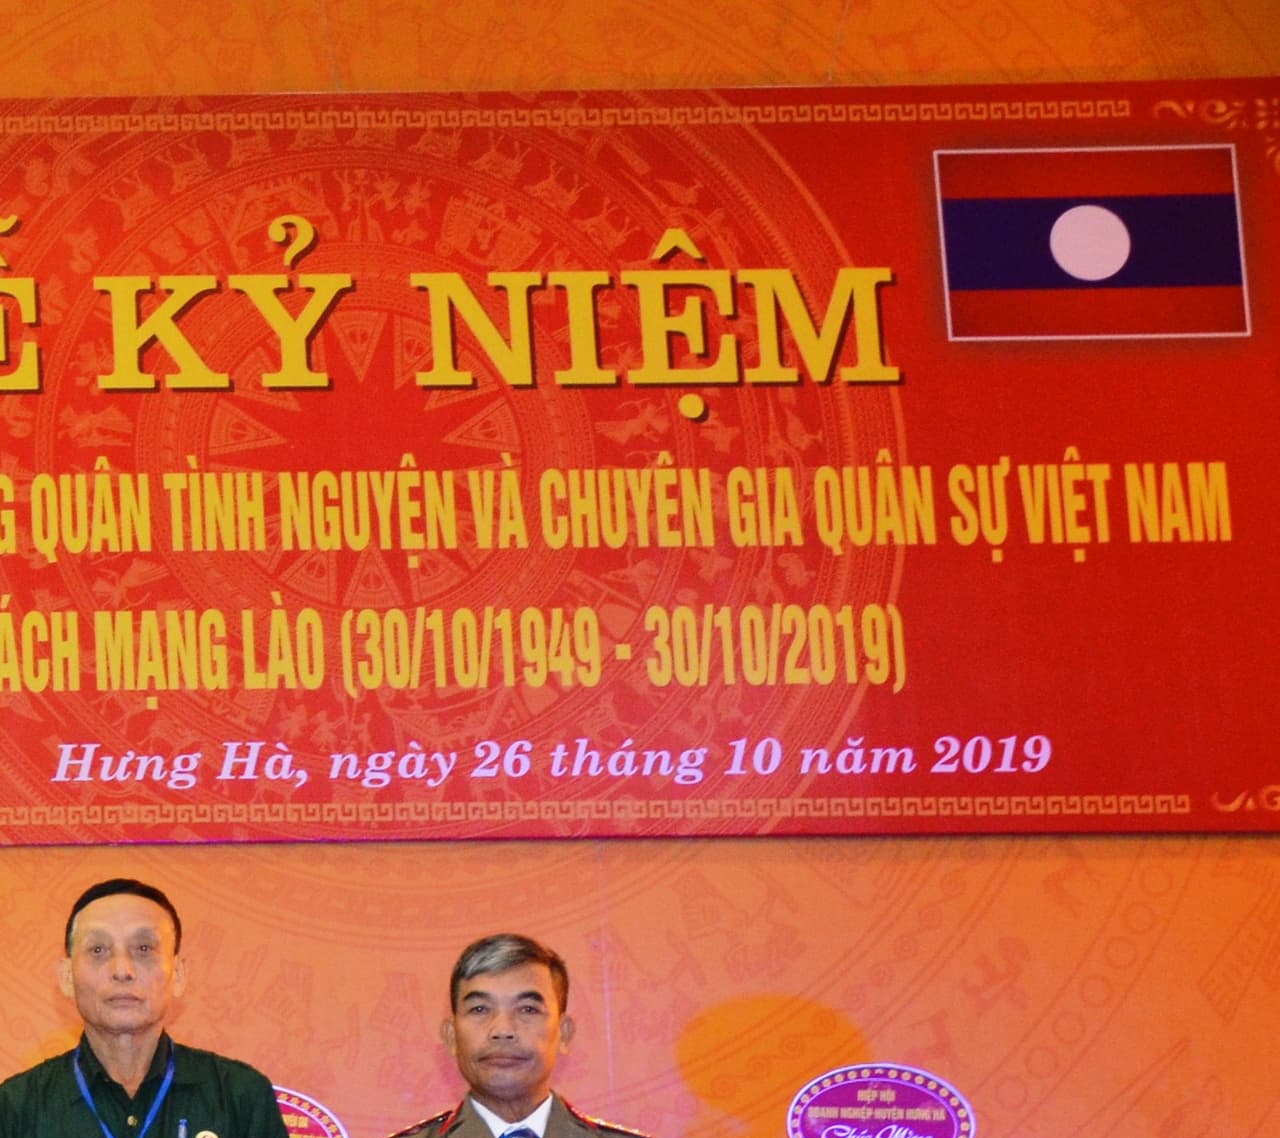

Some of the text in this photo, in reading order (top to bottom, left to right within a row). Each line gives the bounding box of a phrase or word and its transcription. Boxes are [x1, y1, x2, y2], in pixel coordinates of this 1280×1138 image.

[93, 215, 352, 389] KỶ
[410, 229, 899, 418] NIỆM
[30, 456, 152, 563] QUÂN
[163, 455, 266, 552] TÌNH
[278, 453, 457, 569] NGUYỆN
[468, 452, 529, 549] VÀ
[540, 451, 715, 549] CHUYÊN
[727, 467, 803, 547] GIA
[814, 450, 935, 555] QUÂN
[949, 457, 1011, 562] SỰ
[1019, 446, 1109, 562] VIỆT
[1126, 463, 1230, 541] NAM
[94, 608, 229, 710] MẠNG
[241, 591, 325, 690] LÀO
[341, 606, 602, 699] (30/10/1949
[615, 643, 631, 660] -
[645, 603, 905, 692] 30/10/2019)
[50, 735, 1052, 790] Hưng Hà, ngày 26 tháng 10 năm 2019
